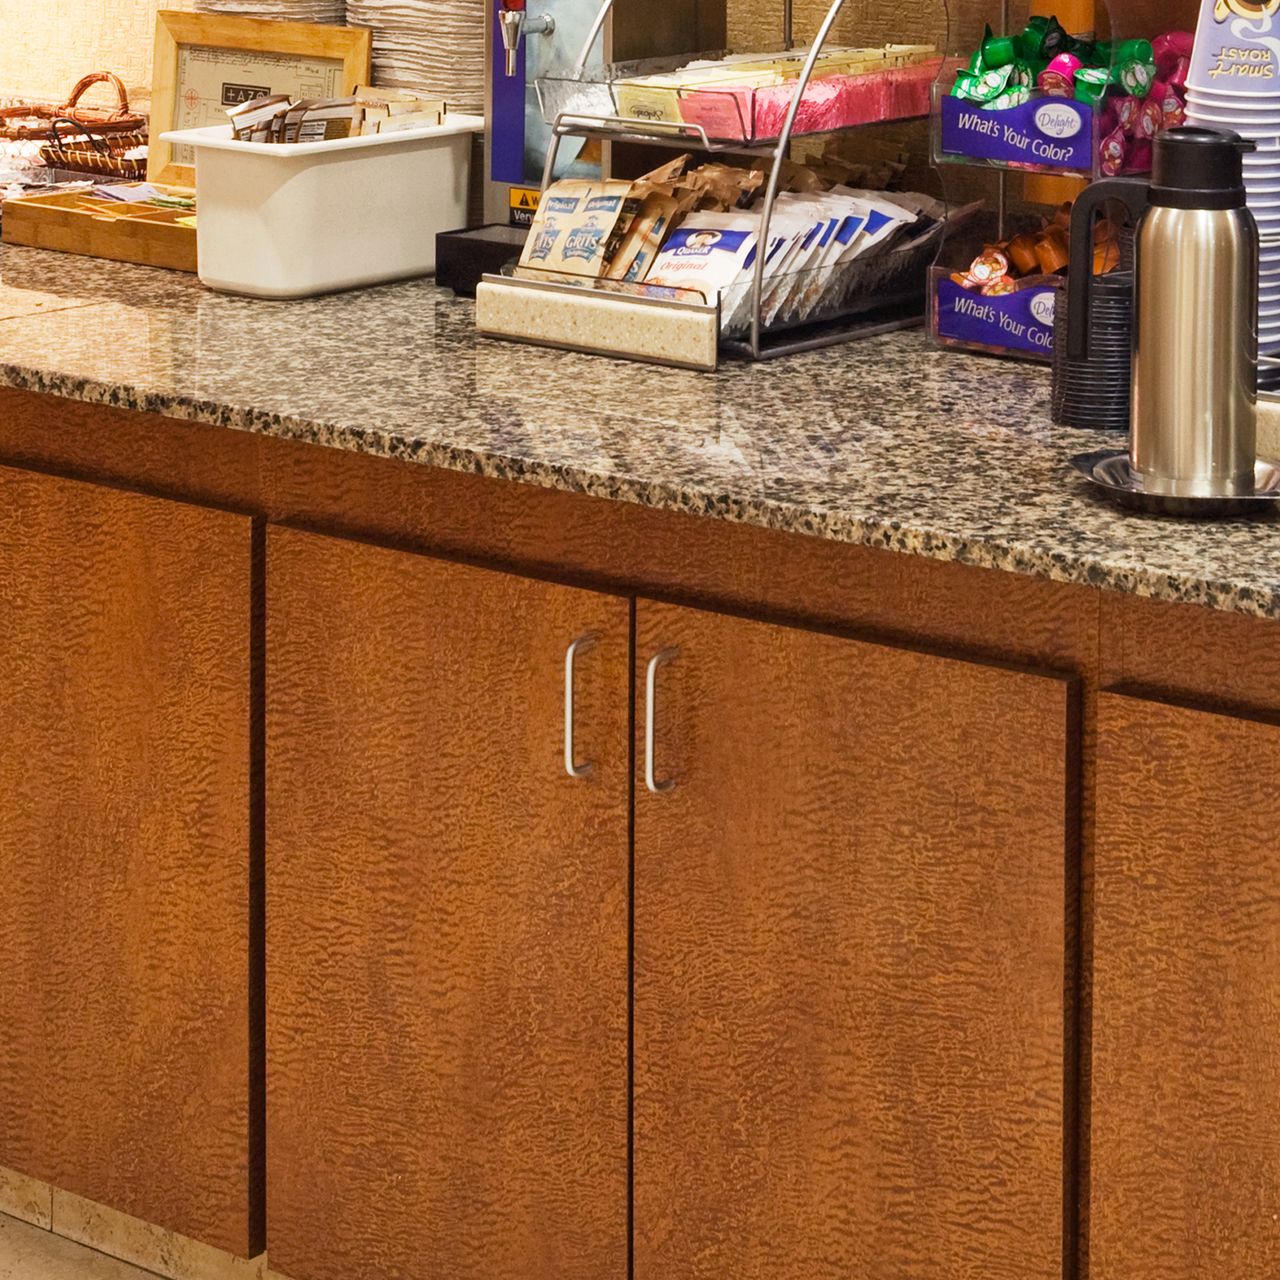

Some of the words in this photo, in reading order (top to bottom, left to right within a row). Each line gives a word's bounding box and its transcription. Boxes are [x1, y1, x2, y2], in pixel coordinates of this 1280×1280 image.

[1217, 46, 1271, 62] ROAST
[958, 113, 1000, 138] What's
[1003, 127, 1032, 150] Your
[1031, 138, 1074, 162] Color?
[1038, 111, 1076, 138] Delight
[954, 296, 996, 323] What's
[998, 310, 1027, 337] Your
[1027, 324, 1053, 350] Colo
